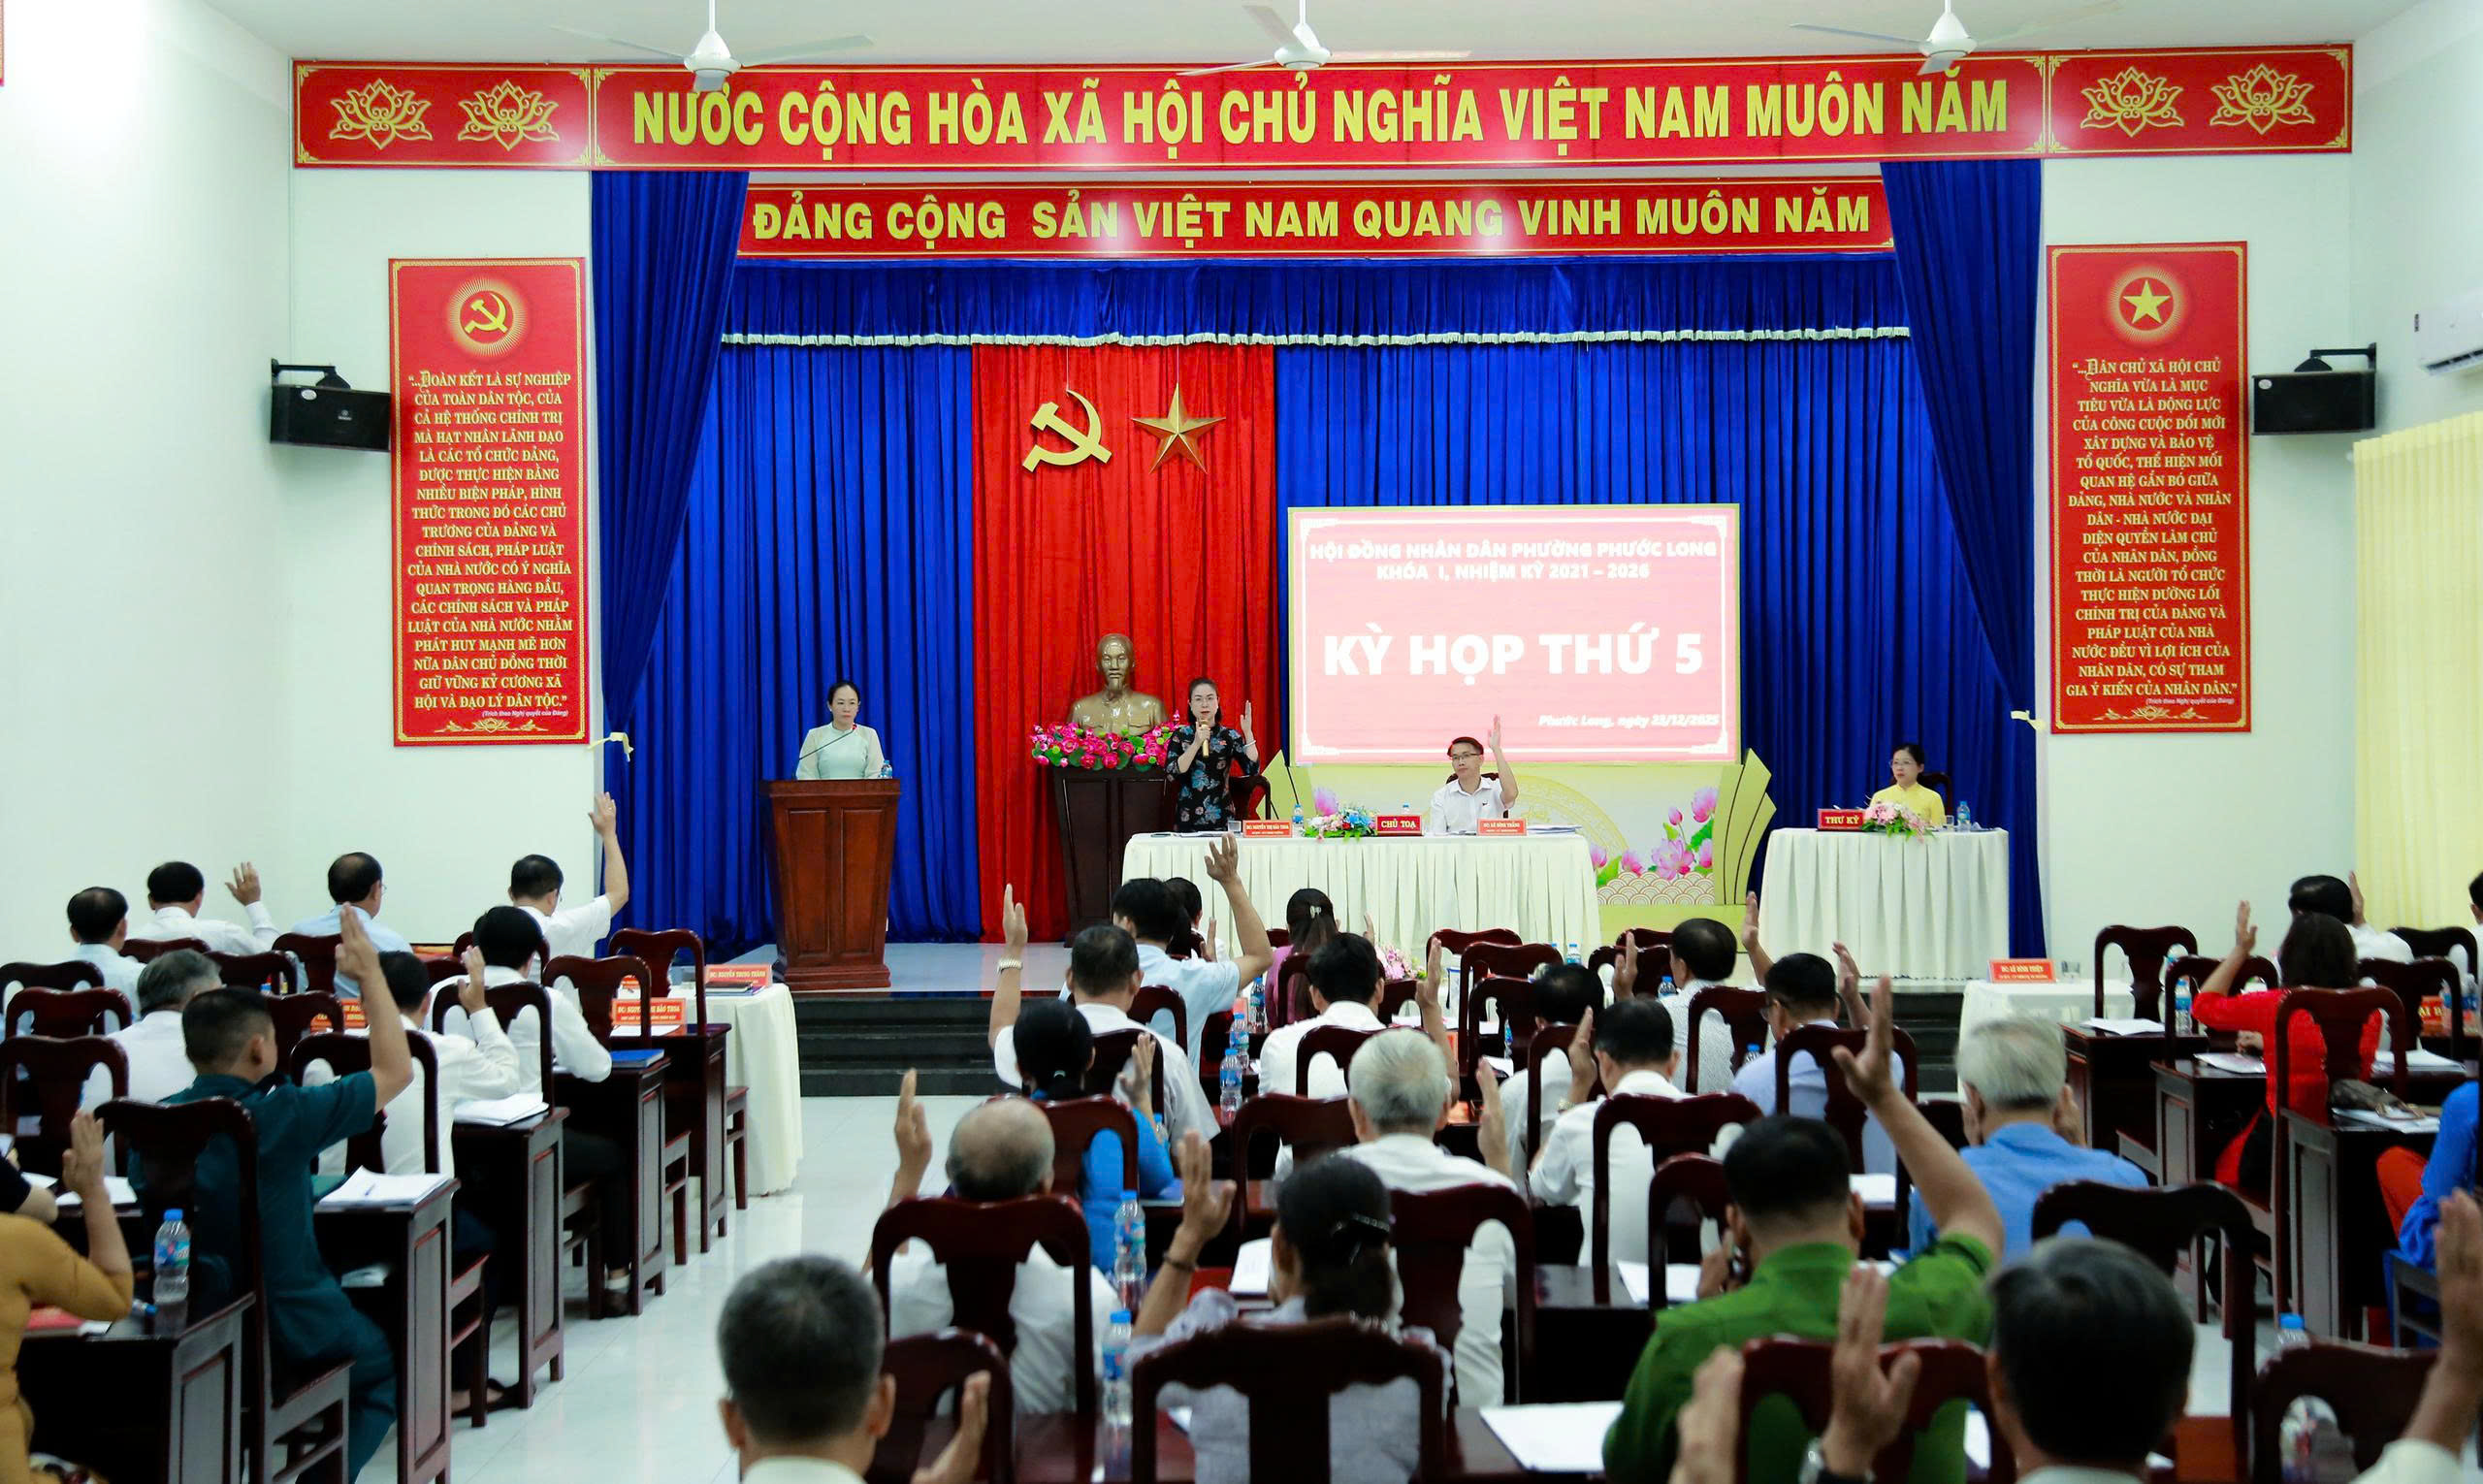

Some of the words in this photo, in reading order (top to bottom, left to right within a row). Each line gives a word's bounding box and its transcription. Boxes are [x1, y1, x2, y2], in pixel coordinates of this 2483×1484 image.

[779, 80, 910, 160] CỘNG
[929, 80, 1027, 145] HÒA
[1044, 79, 1107, 145] XÃ
[1124, 80, 1202, 159] HỘI
[1220, 71, 1316, 145] CHỦ
[1335, 75, 1482, 143] NGHĨA
[1500, 77, 1609, 156] VIỆT
[1626, 87, 1729, 139] NAM
[1747, 72, 1884, 138] MUÔN
[1902, 66, 2007, 133] NĂM
[754, 190, 872, 240] ĐẢNG
[887, 195, 1006, 249] CỘNG
[1033, 189, 1118, 239] SẢN
[1137, 194, 1231, 248] VIỆT
[1246, 202, 1338, 238] NAM
[1354, 200, 1503, 239] QUANG
[1519, 199, 1621, 235] VINH
[1636, 190, 1759, 235] MUÔN
[1775, 187, 1869, 233] NĂM
[460, 368, 483, 386] KẾT
[487, 370, 502, 386] LÀ
[505, 372, 522, 388] SỰ
[525, 369, 571, 388] NGHIỆP
[415, 389, 439, 405] CỦA
[442, 389, 476, 404] TOÀN
[479, 389, 504, 404] DÂN
[537, 388, 562, 403] CỦA
[415, 408, 431, 425] CẢ
[435, 408, 451, 427] HỆ
[541, 410, 563, 426] TRỊ
[415, 427, 433, 443] MÀ
[436, 430, 462, 445] HẠT
[465, 427, 499, 442] NHÂN
[538, 429, 564, 444] ĐẠO
[420, 446, 435, 463] LÀ
[438, 446, 463, 462] CÁC
[419, 468, 453, 483] ĐƯỢC
[456, 468, 489, 482] THỰC
[493, 465, 523, 482] HIỆN
[526, 462, 559, 479] BẰNG
[417, 483, 456, 500] NHIỀU
[459, 484, 488, 501] BIỆN
[531, 483, 562, 499] HÌNH
[412, 502, 445, 519] THỨC
[448, 506, 490, 518] TRONG
[493, 502, 510, 518] ĐÓ
[513, 501, 537, 518] CÁC
[540, 501, 566, 517] CHỦ
[475, 522, 500, 536] CỦA
[503, 521, 537, 536] ĐẢNG
[540, 521, 557, 535] VÀ
[2083, 530, 2112, 546] DIỆN
[2116, 527, 2158, 545] QUYỀN
[2162, 528, 2187, 543] LÀM
[2191, 528, 2217, 542] CHỦ
[497, 541, 530, 556] PHÁP
[532, 540, 564, 558] LUẬT
[1309, 540, 1343, 563] HỘI
[1406, 540, 1462, 559] NHÂN
[1466, 540, 1507, 558] DÂN
[1666, 541, 1717, 557] LONG
[2083, 549, 2108, 563] CỦA
[2112, 548, 2146, 562] NHÂN
[2183, 545, 2216, 561] ĐỒNG
[1376, 562, 1429, 581] KHÓA
[1455, 561, 1515, 583] NHIỆM
[1520, 561, 1545, 579] KỲ
[1548, 563, 1590, 578] 2021
[1607, 563, 1650, 579] 2026
[2076, 567, 2105, 582] THỜI
[2110, 566, 2124, 582] LÀ
[2129, 566, 2167, 581] NGƯỜI
[2081, 589, 2114, 602] THỰC
[2118, 585, 2148, 601] HIỆN
[2200, 582, 2219, 598] LỐI
[2119, 607, 2139, 622] TRỊ
[2143, 604, 2168, 619] CỦA
[2173, 603, 2206, 618] ĐẢNG
[2209, 603, 2225, 618] VÀ
[2088, 624, 2121, 638] PHÁP
[2125, 624, 2156, 639] LUẬT
[2160, 623, 2184, 637] CỦA
[2188, 623, 2214, 636] NHÀ
[1324, 623, 1393, 676] KỲ
[1409, 633, 1525, 686] HỌP
[1538, 623, 1661, 675] THỨ
[1675, 632, 1703, 675] 5
[2073, 643, 2106, 658] NƯỚC
[2111, 640, 2135, 657] ĐỀU
[2139, 642, 2151, 657] VÌ
[2155, 645, 2176, 659] LỢI
[2180, 641, 2201, 656] ÍCH
[2206, 641, 2230, 656] CỦA
[2080, 662, 2113, 677] NHÂN
[2149, 661, 2166, 676] CÓ
[2170, 664, 2185, 678] SỰ
[2188, 664, 2223, 675] THAM
[2066, 685, 2087, 695] GIA
[2091, 681, 2099, 695] Ý
[2103, 679, 2132, 695] KIẾN
[2136, 680, 2161, 694] CỦA
[2165, 679, 2199, 694] NHÂN
[1381, 819, 1398, 828] CHỦ
[1824, 816, 1845, 824] THƯ
